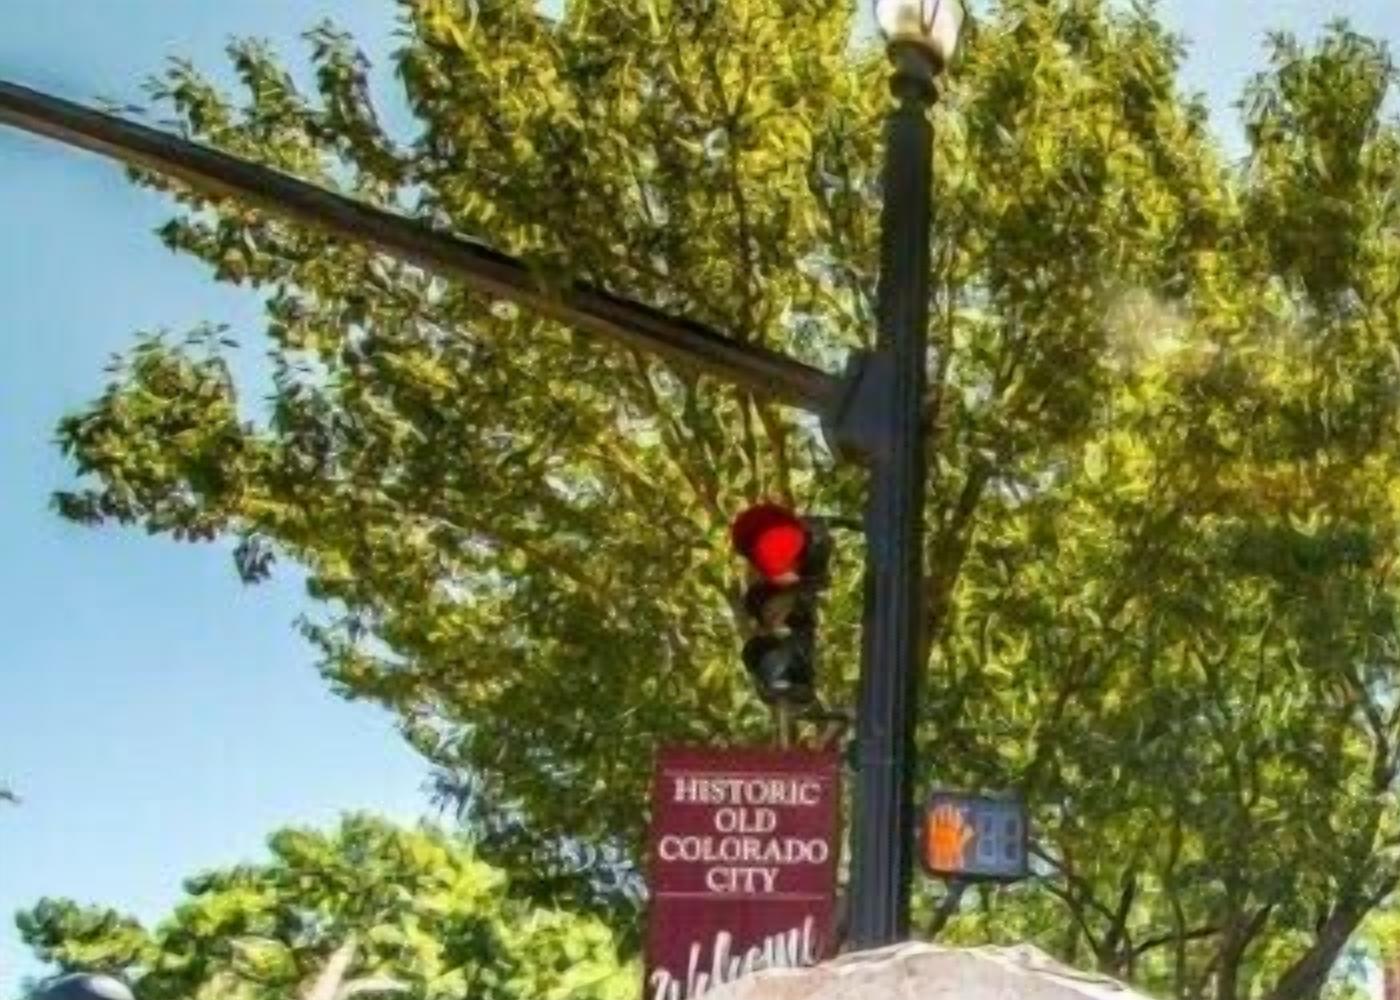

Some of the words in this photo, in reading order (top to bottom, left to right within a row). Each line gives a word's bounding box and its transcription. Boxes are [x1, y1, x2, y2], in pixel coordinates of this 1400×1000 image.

[674, 777, 822, 806] HISTORIC
[714, 806, 777, 833] OLD
[659, 835, 829, 865] COLORADO
[705, 866, 779, 893] CITY
